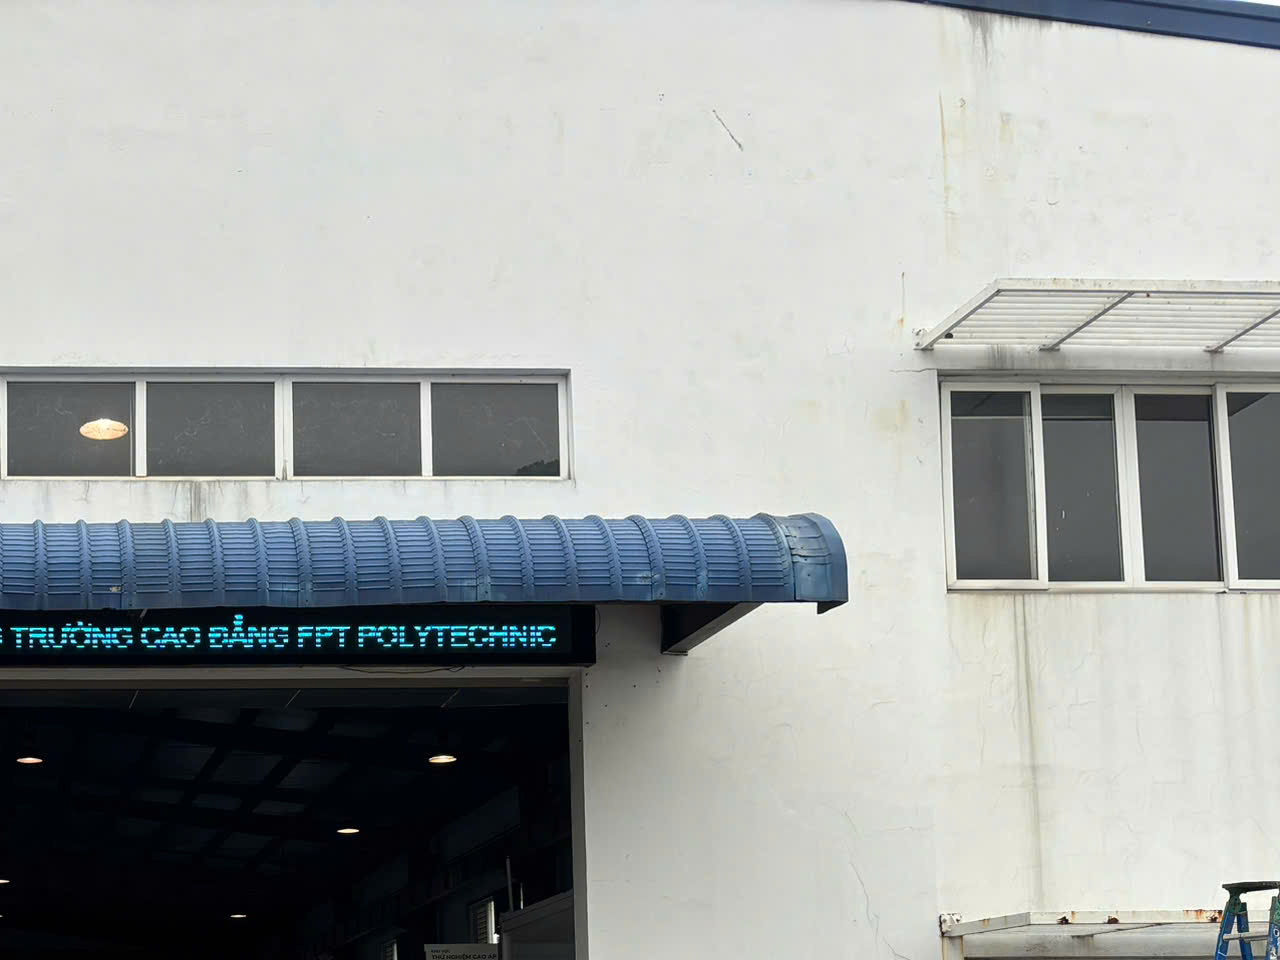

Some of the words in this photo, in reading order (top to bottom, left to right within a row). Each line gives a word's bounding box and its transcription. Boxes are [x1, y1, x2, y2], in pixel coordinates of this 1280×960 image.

[10, 621, 133, 649] TRƯỜNG
[141, 626, 201, 648] CAO
[297, 626, 351, 648] FPT
[358, 626, 557, 648] POLYTECHNIC
